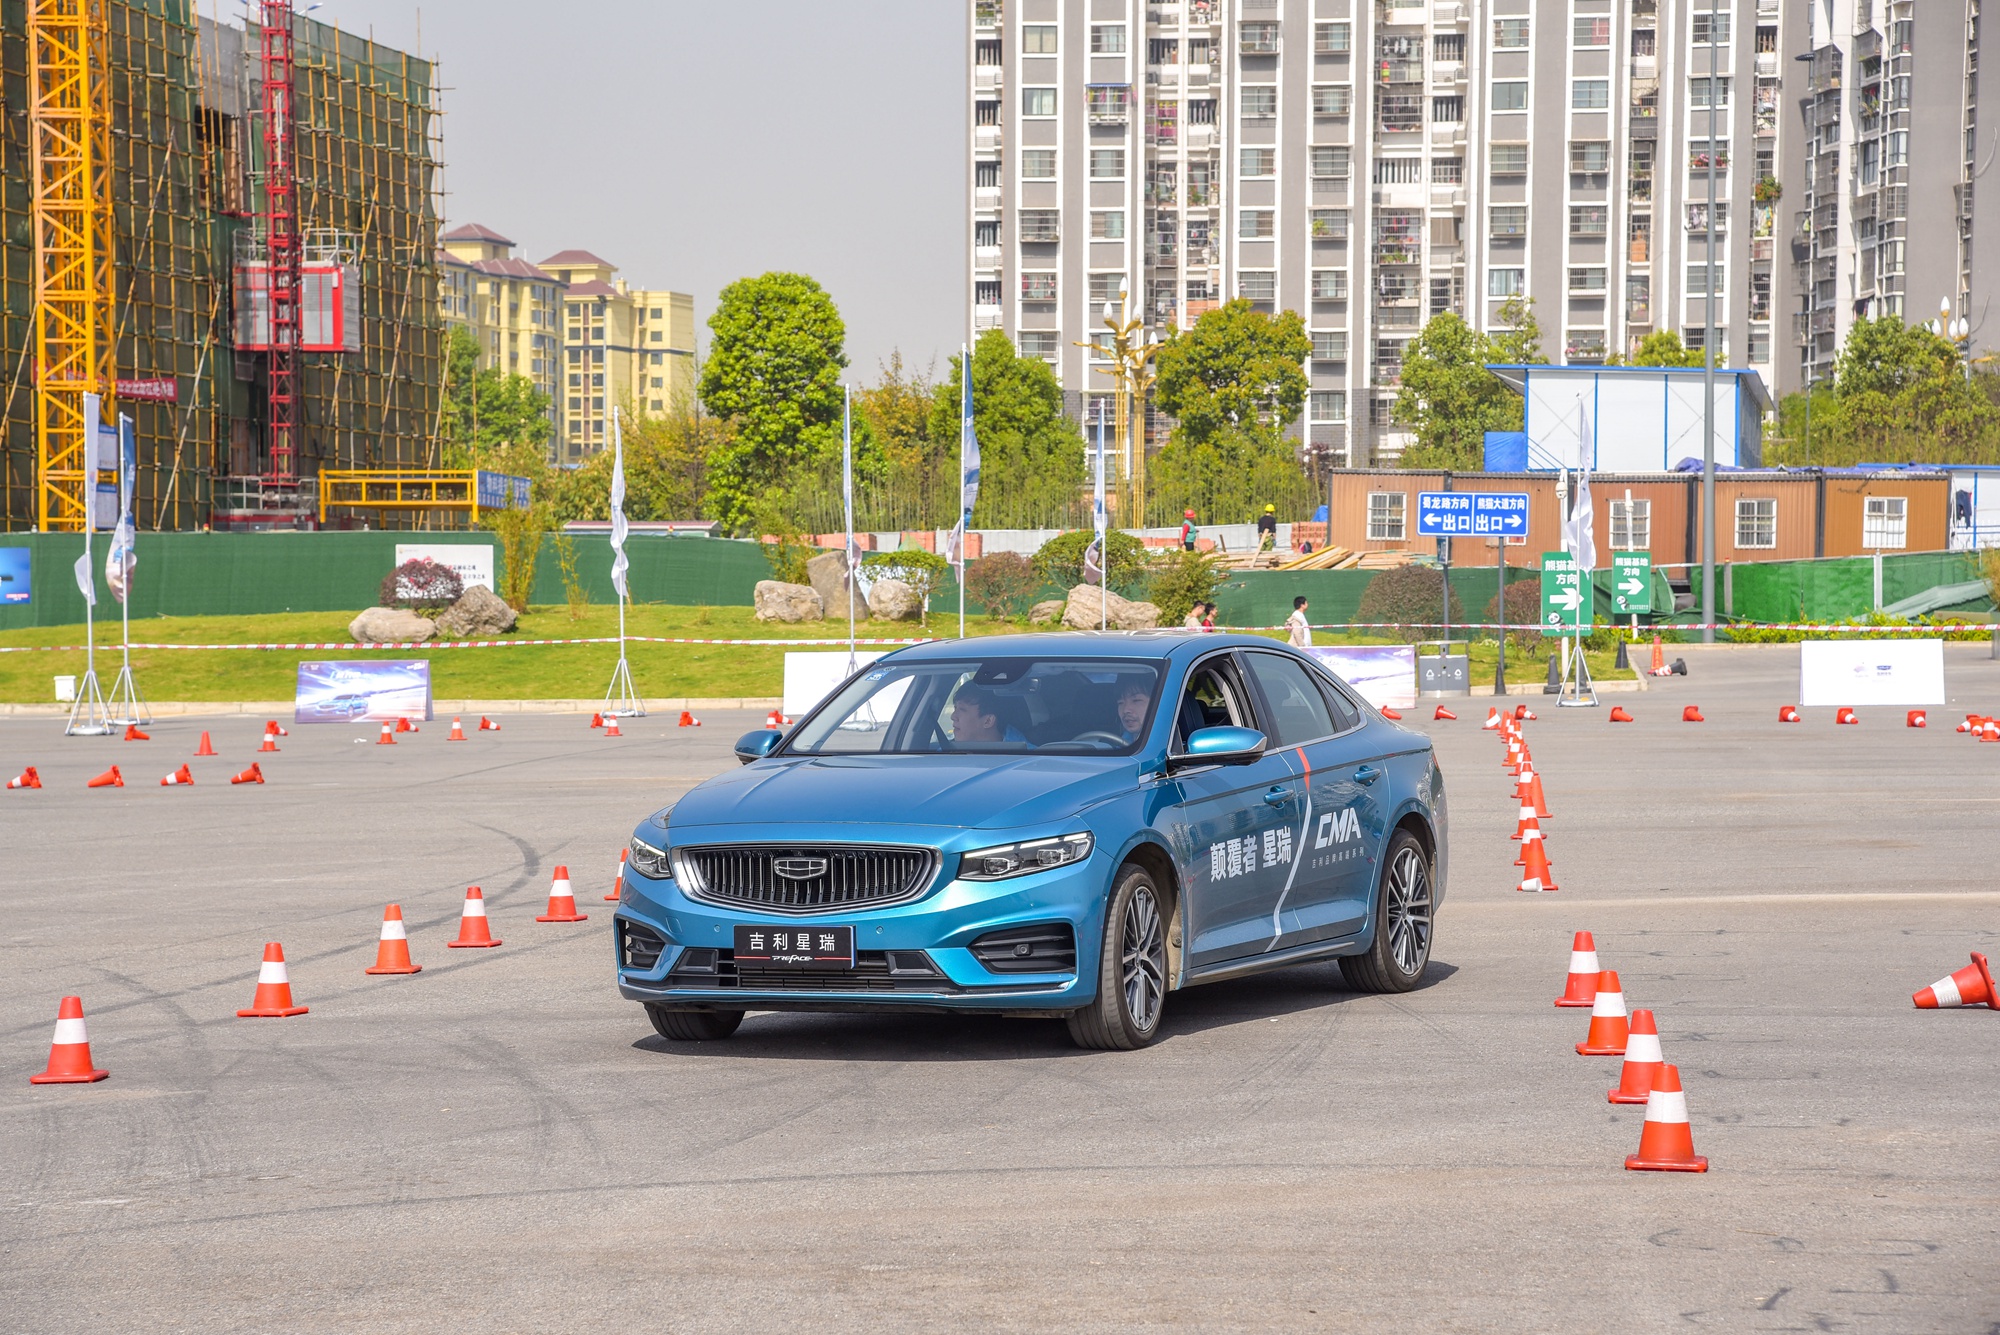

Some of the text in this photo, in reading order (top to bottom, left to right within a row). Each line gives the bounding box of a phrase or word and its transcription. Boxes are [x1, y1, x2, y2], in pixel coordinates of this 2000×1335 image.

[1422, 496, 1470, 510] 蜀龙路方向
[1477, 497, 1525, 510] 熊猫大道方向
[1442, 513, 1470, 531] 出口
[1475, 513, 1503, 532] 出口
[1615, 557, 1649, 567] 熊猫基地
[1555, 573, 1578, 585] 方向
[1623, 567, 1640, 576] 方向
[1315, 807, 1362, 849] CMA
[1210, 835, 1258, 883] 颠覆者
[1263, 825, 1292, 869] 星瑞
[749, 931, 836, 952] 吉利星瑞
